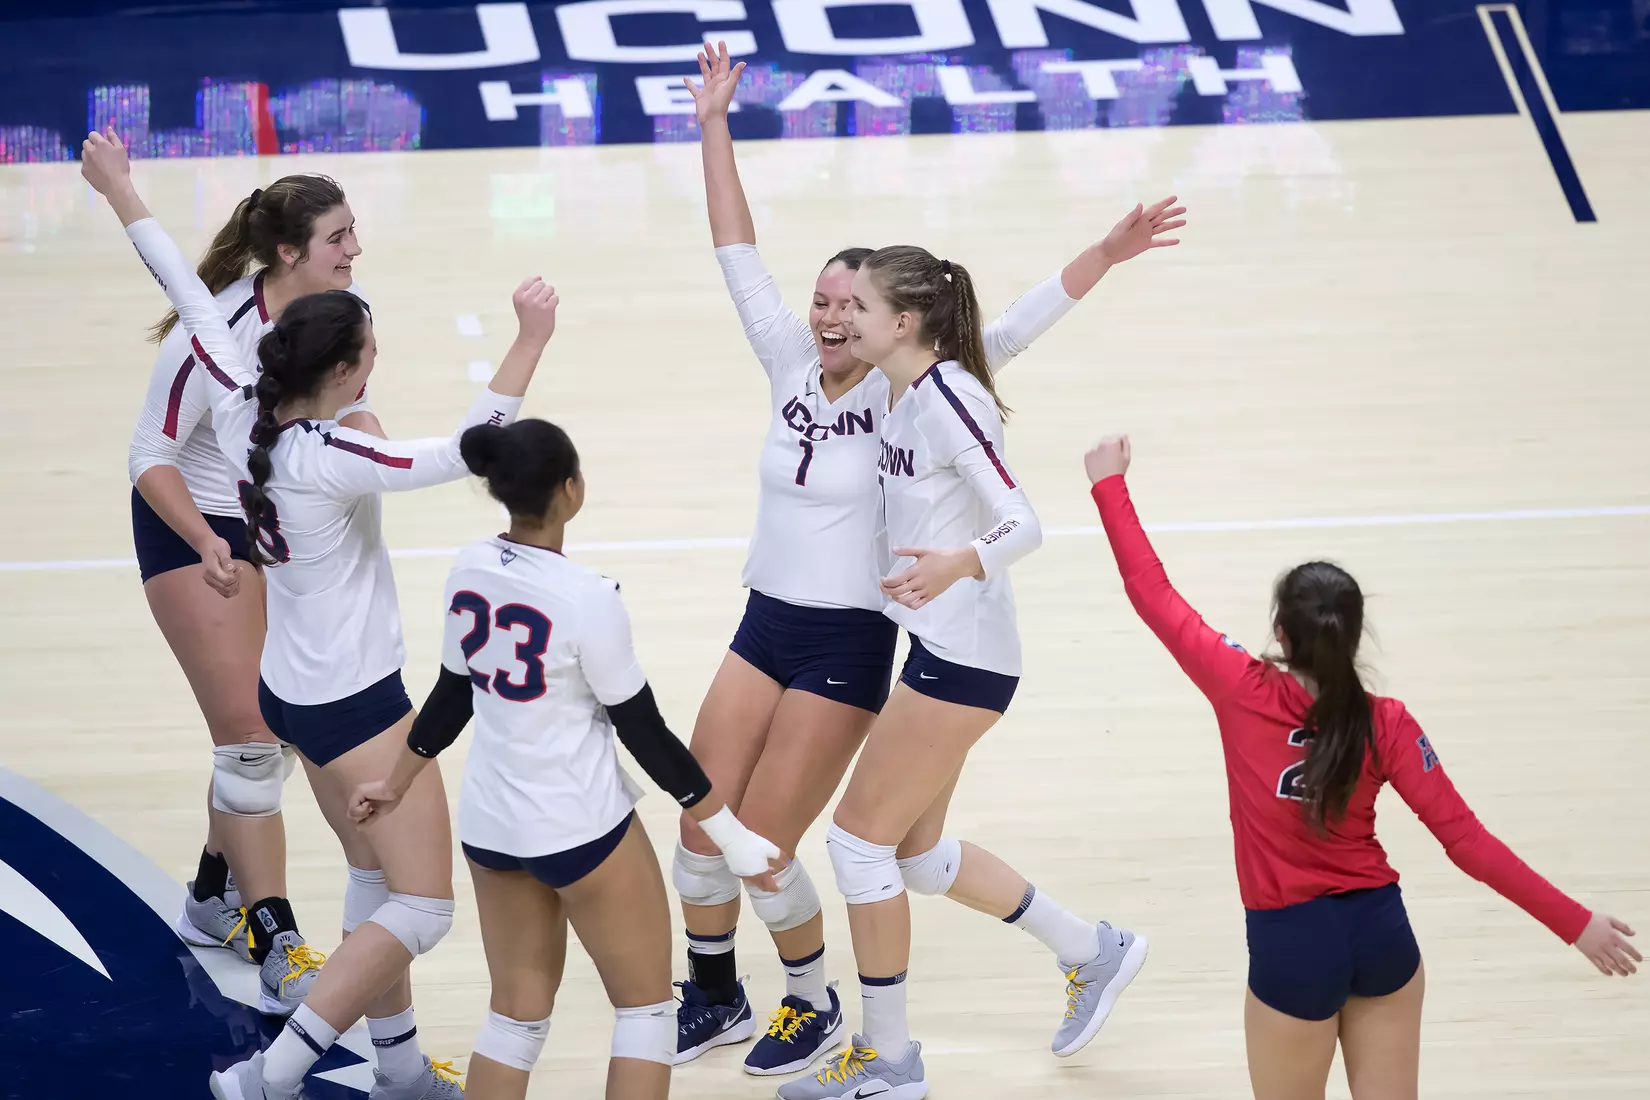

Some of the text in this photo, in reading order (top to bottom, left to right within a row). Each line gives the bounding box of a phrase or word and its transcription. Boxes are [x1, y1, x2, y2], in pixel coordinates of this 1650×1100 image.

[338, 0, 1405, 71] UCONN
[479, 55, 1302, 121] HEALTH
[781, 395, 874, 441] UCONN
[448, 590, 553, 702] 23
